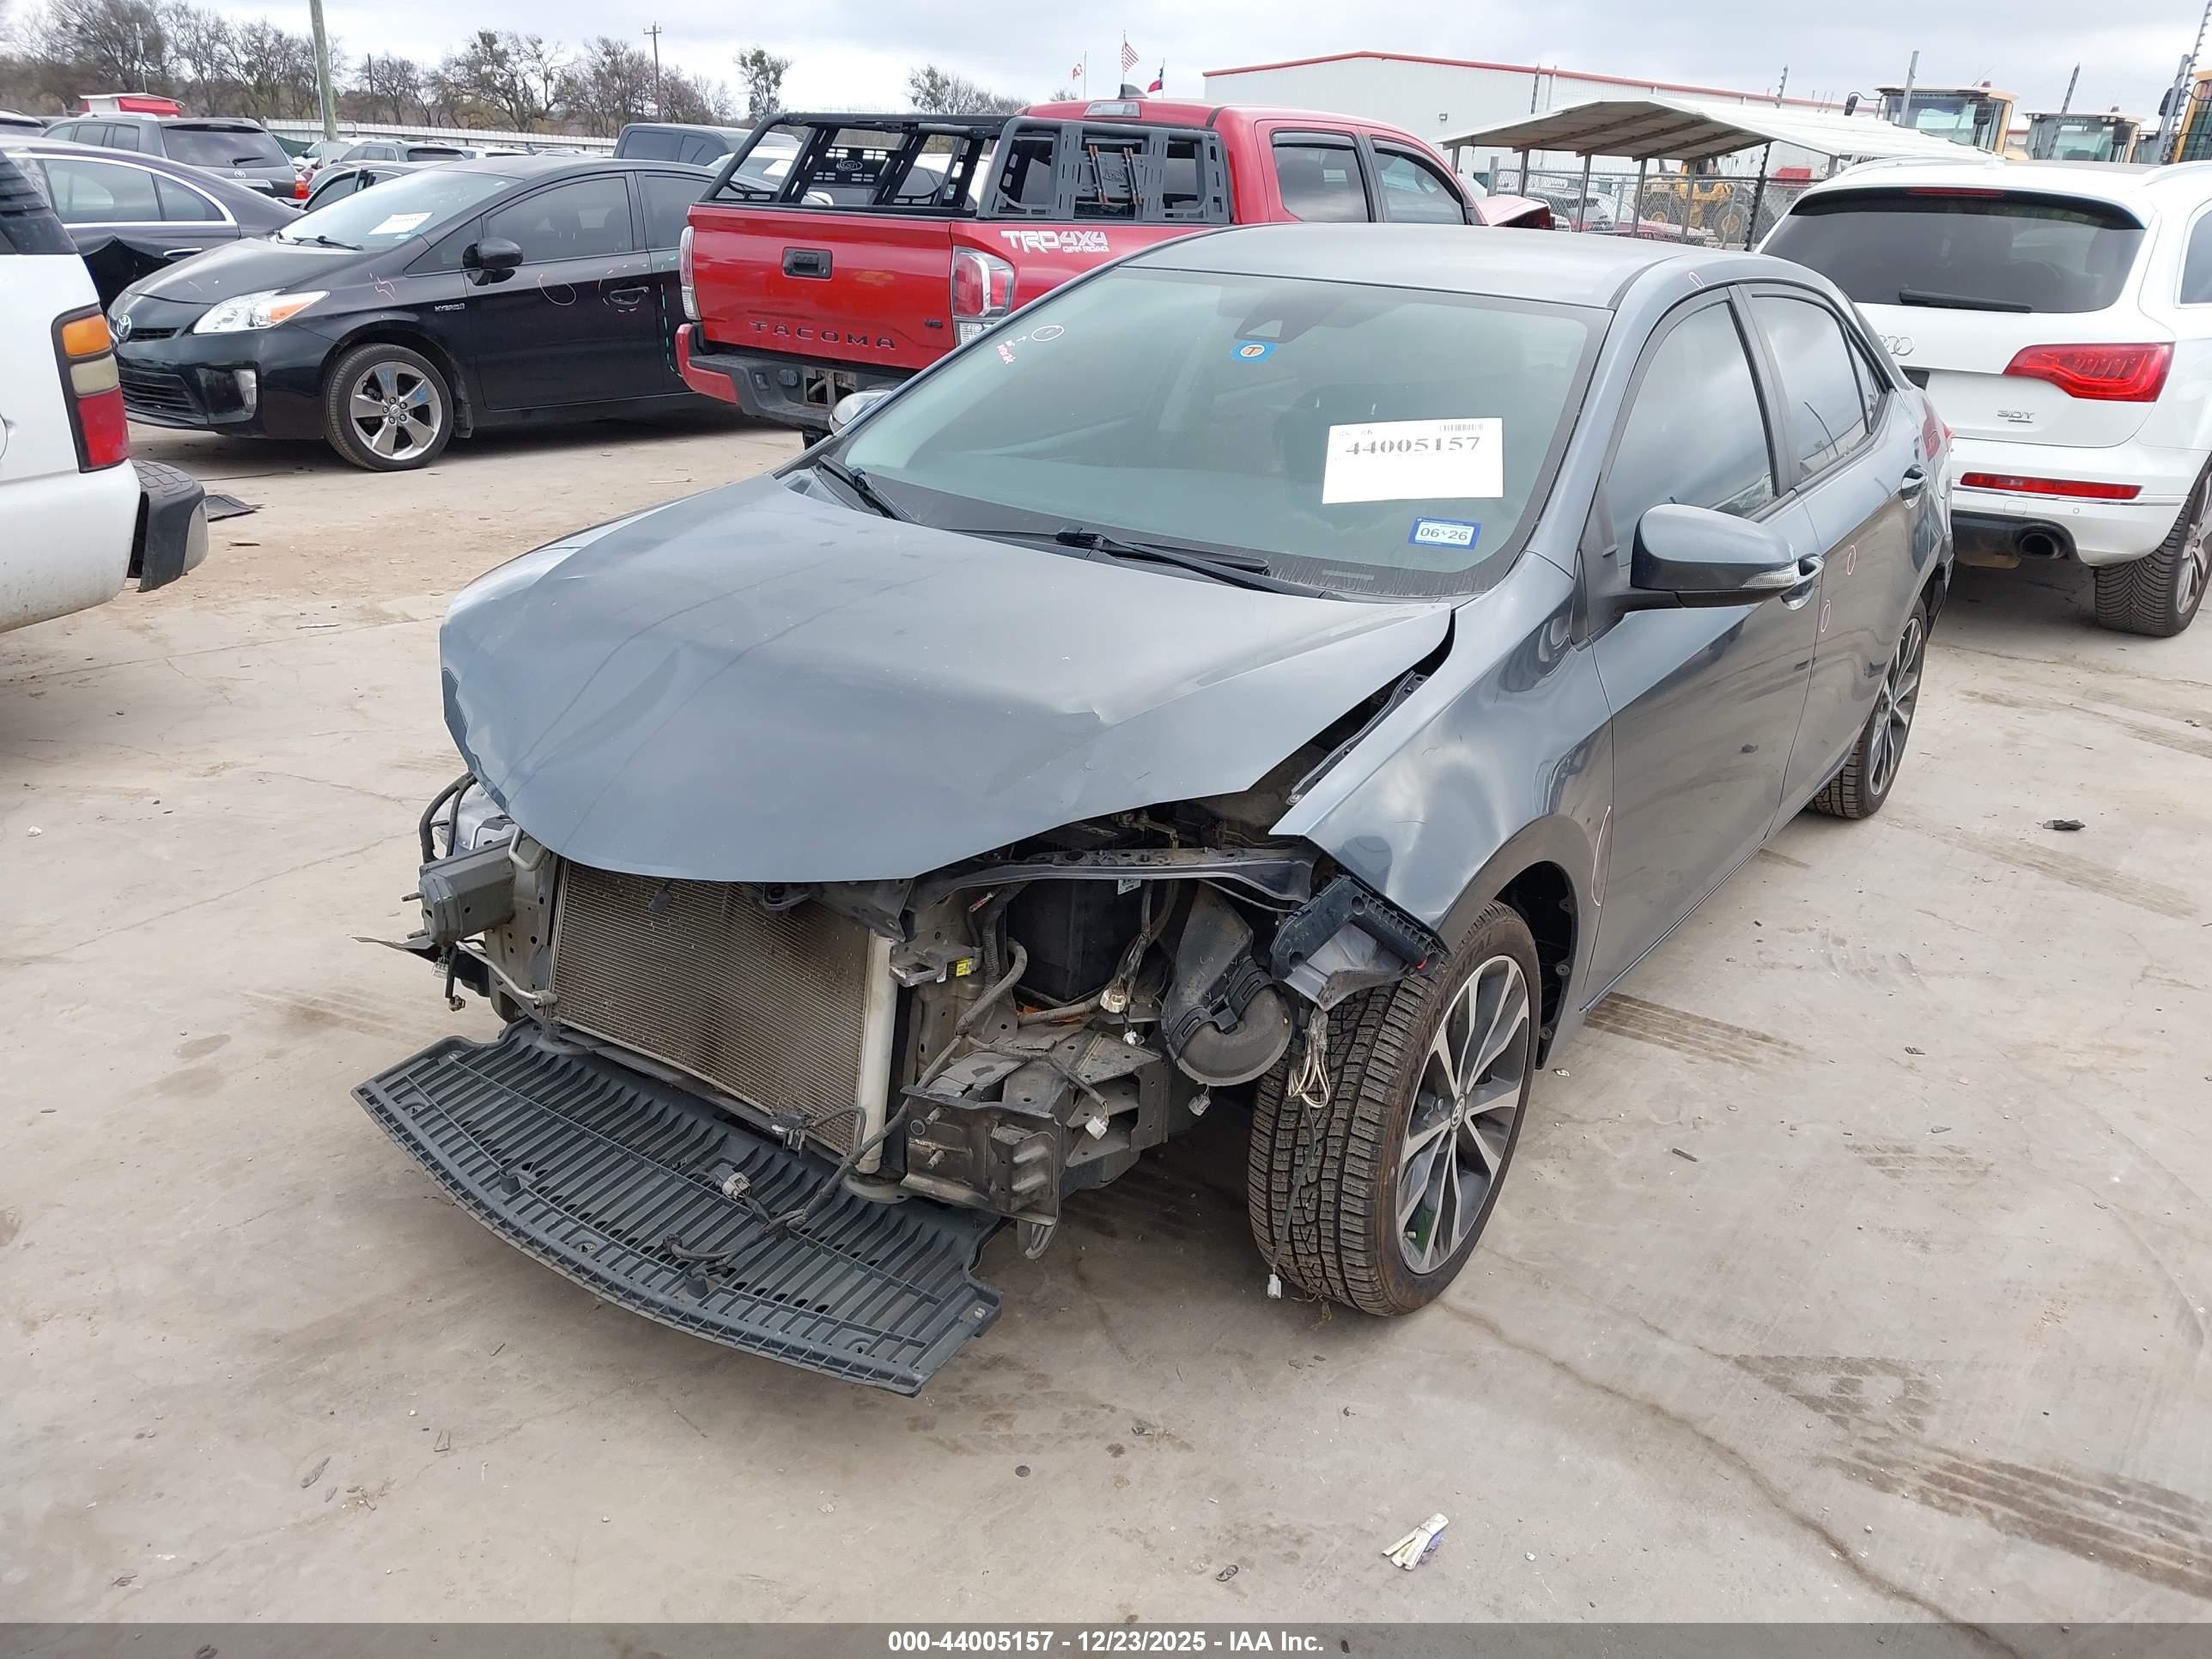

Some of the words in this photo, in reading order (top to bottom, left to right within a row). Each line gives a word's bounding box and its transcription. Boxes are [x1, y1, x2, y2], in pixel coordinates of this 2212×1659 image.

[1000, 230, 1061, 253] TRD
[1059, 230, 1109, 246] 4X4
[749, 320, 896, 350] TACOMA
[1346, 435, 1481, 455] 44005157
[1419, 527, 1441, 538] 06
[1447, 530, 1469, 541] 26
